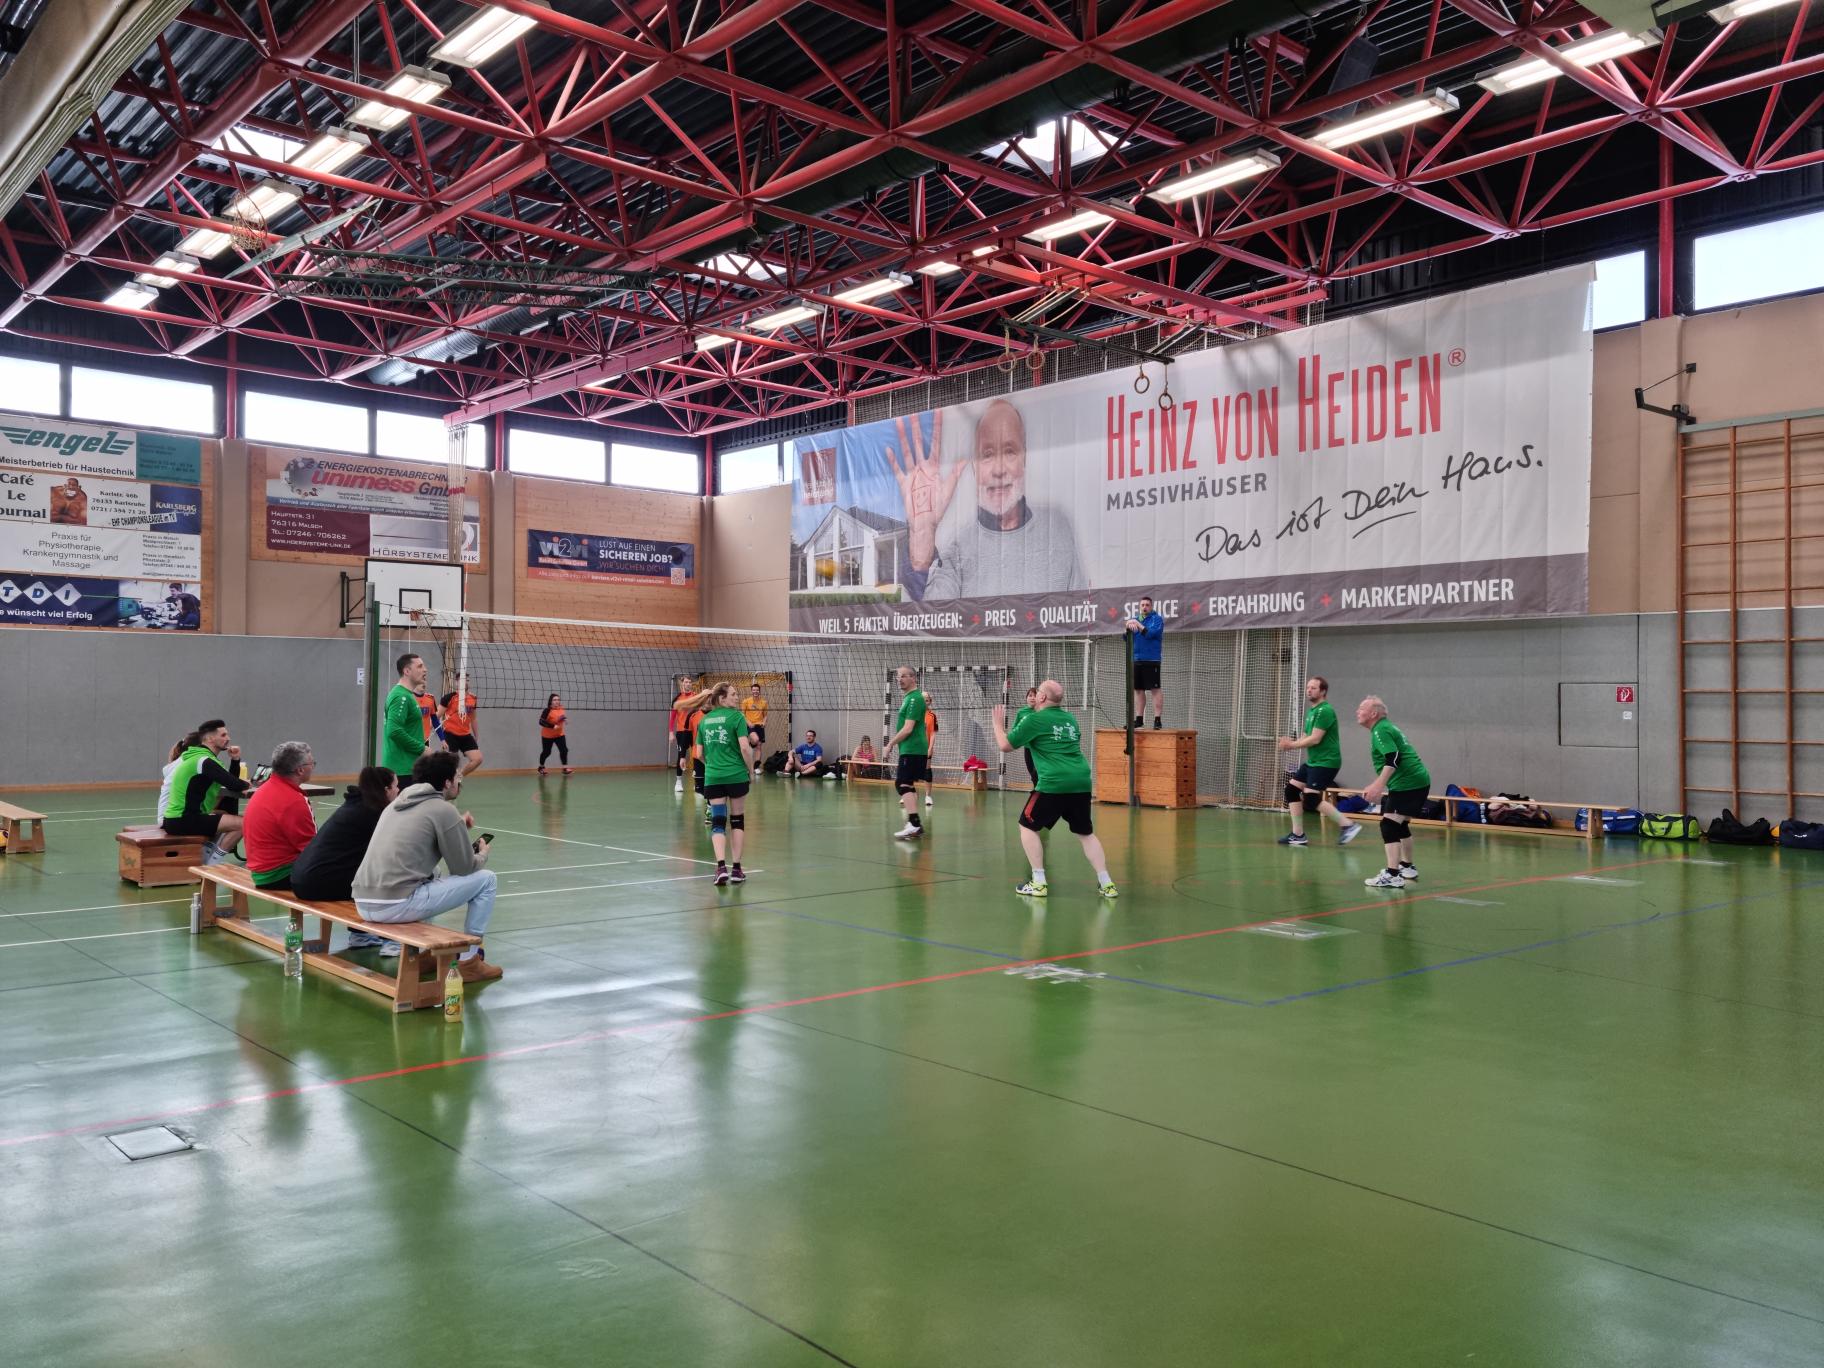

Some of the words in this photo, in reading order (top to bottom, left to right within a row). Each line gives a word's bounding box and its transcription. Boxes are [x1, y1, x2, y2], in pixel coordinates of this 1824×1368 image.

[1107, 393, 1198, 481] HEINZ
[1212, 386, 1279, 465] VON
[1298, 351, 1442, 453] HEIDEN
[24, 430, 124, 456] engel
[0, 456, 63, 469] Meisterbetrieb
[65, 462, 79, 471] für
[80, 464, 135, 477] Haustechnik
[318, 461, 467, 483] ENERGIEKOSTENABRECHN
[0, 473, 34, 485] Café
[311, 469, 417, 494] unimess
[419, 482, 449, 497] Gmb
[8, 490, 26, 500] Le
[1106, 472, 1269, 511] MASSIVHÄUSER
[156, 501, 197, 513] KARLSBERG
[1196, 525, 1262, 562] Das
[1276, 497, 1330, 540] ist
[1342, 481, 1429, 521] Dein
[1442, 444, 1544, 491] Haus.
[0, 508, 46, 518] ournal
[298, 521, 323, 529] MALSCH
[51, 532, 78, 541] Praxis
[80, 533, 92, 542] für
[286, 529, 312, 537] 07246
[317, 532, 347, 540] 706262
[39, 540, 104, 552] Physiotherapie,
[599, 540, 617, 548] LUST
[618, 542, 633, 550] AUF
[634, 543, 656, 552] EINEN
[23, 549, 101, 561] Krankengymnastik
[103, 554, 119, 562] und
[372, 547, 448, 560] HÖRSYSTEME
[599, 549, 648, 562] SICHEREN
[649, 554, 673, 564] JOB?
[52, 560, 91, 569] Massage
[600, 561, 614, 569] WIR
[615, 562, 645, 571] SUCHEN
[819, 619, 841, 634] WEIL
[844, 618, 850, 632] 5
[853, 616, 889, 632] FAKTEN
[893, 612, 963, 631] ÜBERZEUGEN:
[984, 609, 1017, 627] PREIS
[1040, 600, 1098, 628] QUALITÄT
[1124, 599, 1179, 620] SEICE
[1208, 591, 1305, 617] ERFAHRUNG
[1341, 578, 1514, 609] MARKENPARTNER
[7, 608, 46, 617] wünscht
[66, 612, 93, 620] Erfolg
